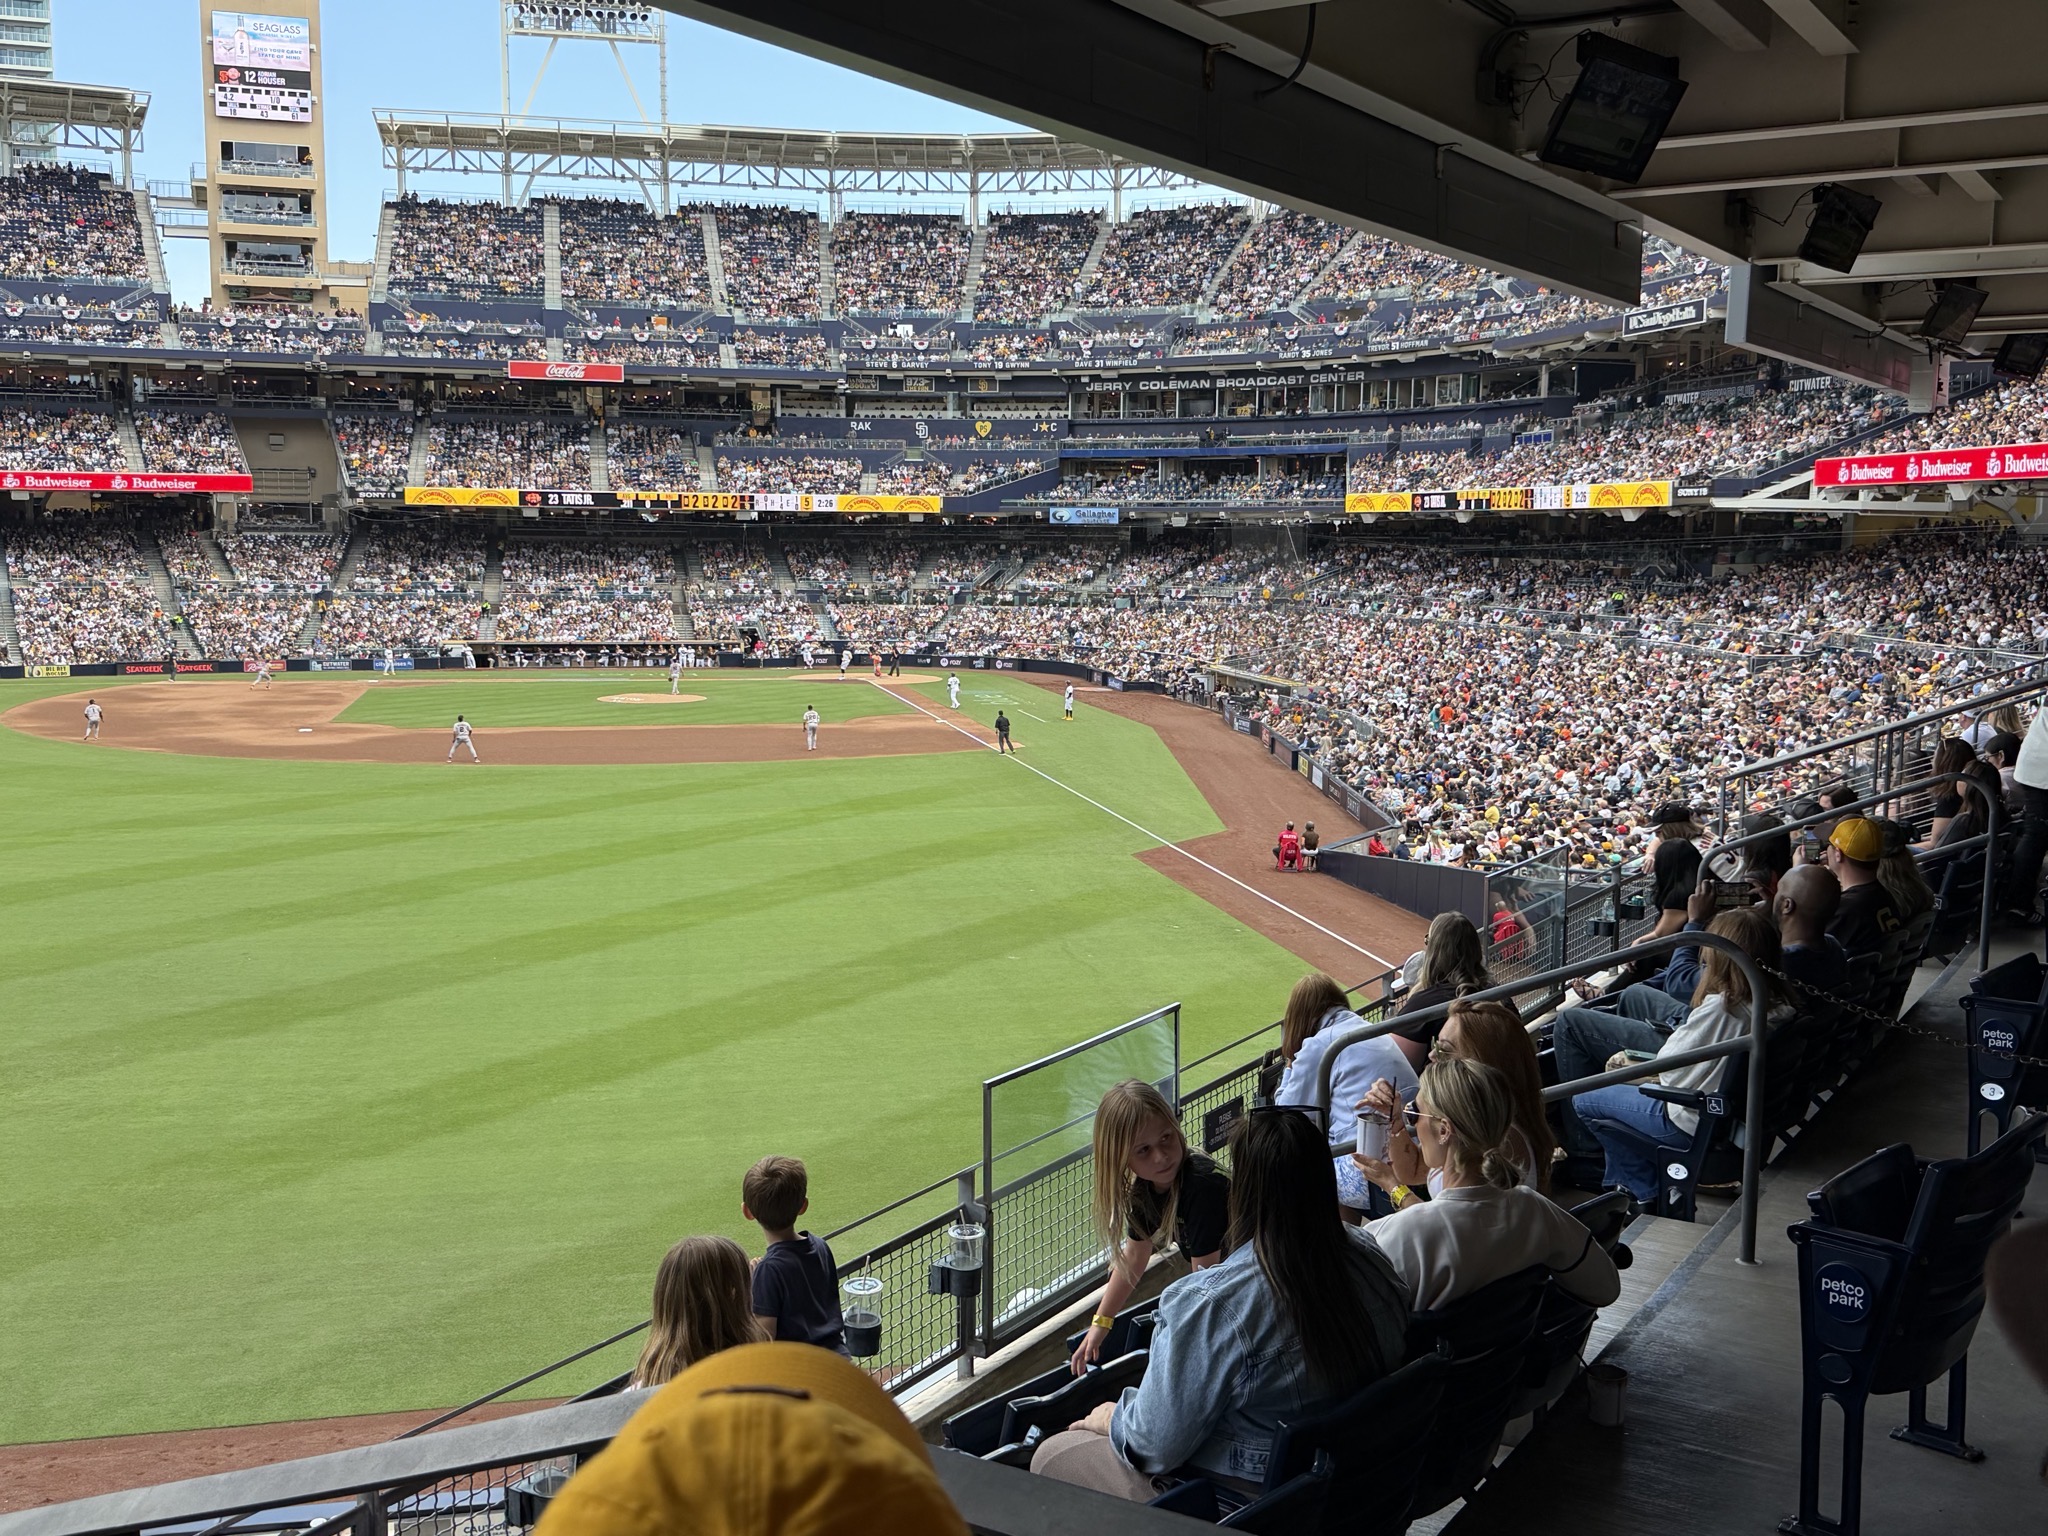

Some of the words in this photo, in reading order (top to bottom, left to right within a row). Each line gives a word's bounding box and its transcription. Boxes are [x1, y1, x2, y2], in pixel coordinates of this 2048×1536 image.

[253, 23, 300, 34] SEAGLASS
[244, 70, 256, 82] 12
[258, 77, 285, 85] HOUSER
[1368, 344, 1390, 352] TREVOR
[1391, 342, 1399, 350] 51
[1401, 340, 1428, 348] HOFFMAN
[546, 364, 587, 378] Coca-Cola
[1086, 382, 1132, 391] JERRY
[1139, 379, 1210, 390] COLEMAN
[1216, 375, 1304, 388] BROADCAST
[1310, 371, 1365, 383] CENTER
[1789, 376, 1832, 391] CUTWATER
[851, 422, 871, 431] RAK
[1033, 423, 1038, 431] J
[1051, 423, 1057, 431] C
[1851, 463, 1894, 481] Budweiser
[1921, 459, 1972, 477] Budweiser
[25, 476, 92, 488] Budweiser
[132, 478, 197, 489] Budweiser
[548, 494, 559, 504] 23
[562, 494, 584, 505] TATIS
[1566, 489, 1570, 502] 5
[1575, 491, 1586, 503] 2:26
[693, 495, 698, 508] 2
[712, 495, 718, 508] 2
[731, 495, 737, 508] 2
[804, 497, 809, 506] 5
[818, 499, 833, 507] 2:26
[1076, 510, 1116, 518] Gallagher
[126, 664, 163, 673] SEATGEEK
[176, 664, 213, 672] SEATGEEK
[1983, 1030, 2013, 1040] petco
[1988, 1039, 2014, 1048] park
[1989, 1088, 1995, 1096] 3
[1675, 1168, 1680, 1176] 2
[1822, 1278, 1864, 1297] petco
[1829, 1292, 1864, 1309] park
